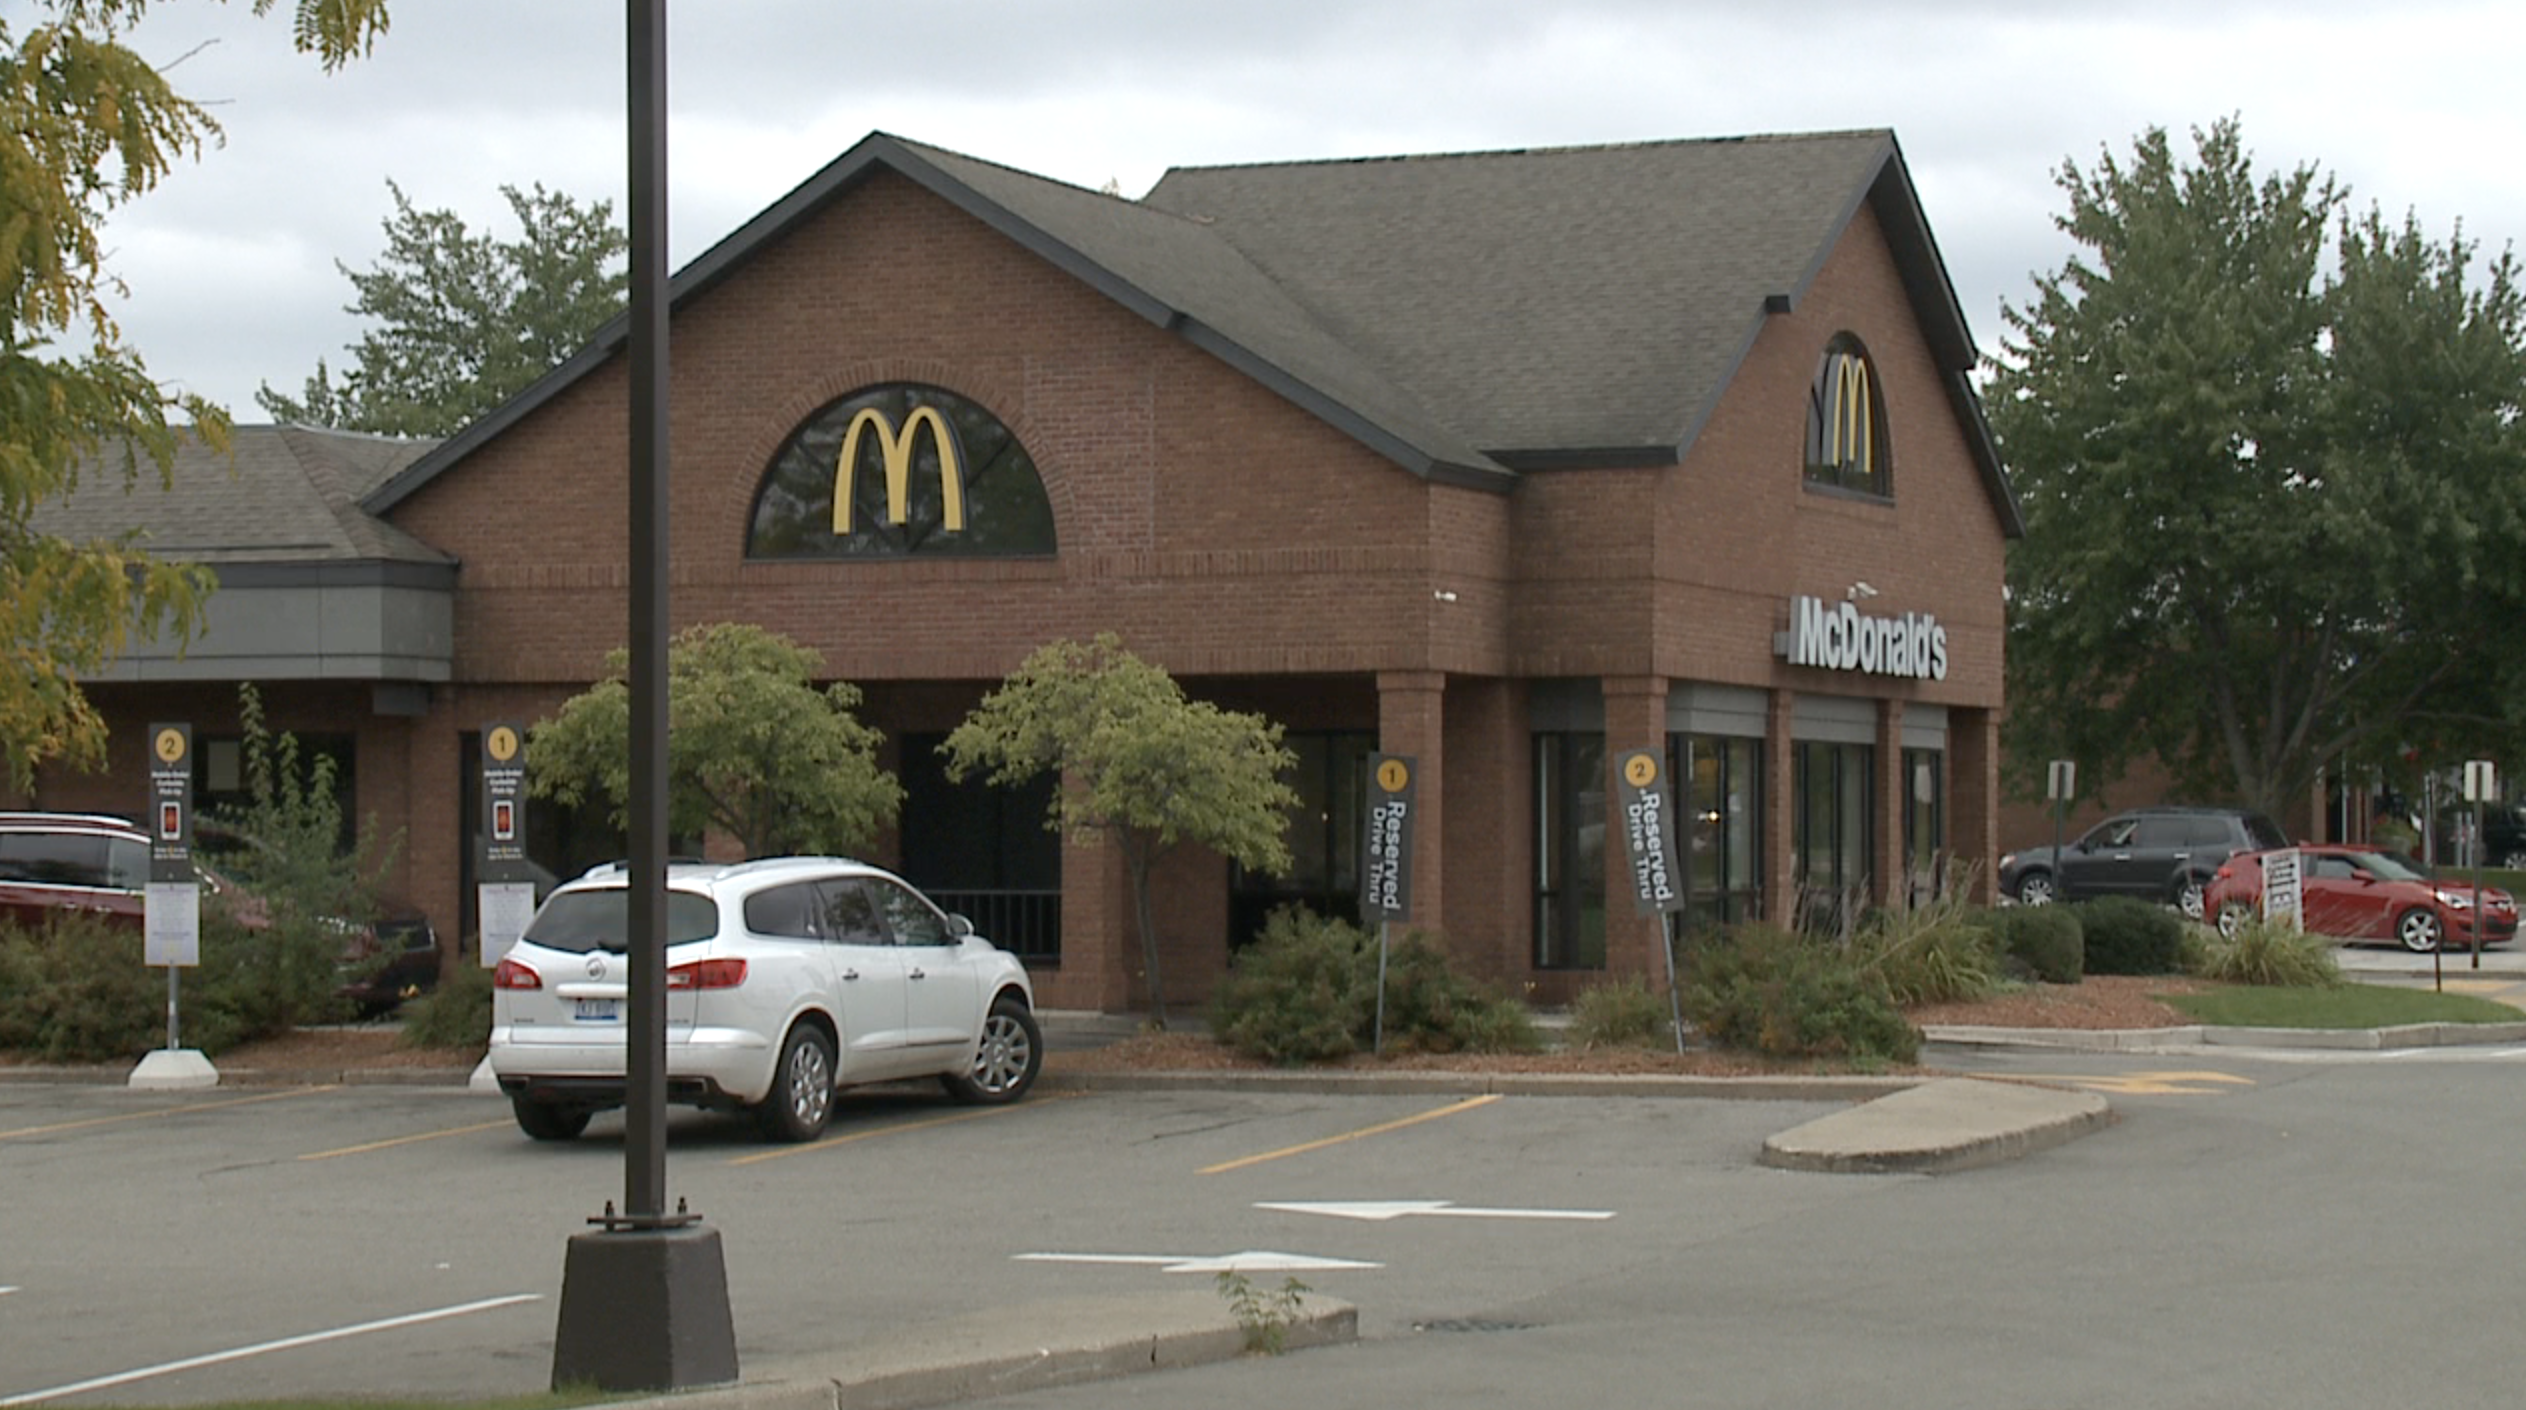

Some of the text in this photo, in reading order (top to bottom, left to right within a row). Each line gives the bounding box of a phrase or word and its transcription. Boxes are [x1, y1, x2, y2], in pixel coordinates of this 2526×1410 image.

[1797, 595, 1948, 681] McDonald's
[164, 737, 176, 754] 2
[1634, 762, 1647, 778] 2
[1369, 807, 1387, 905] Drive Thru
[1383, 801, 1407, 910] Reserved
[1628, 803, 1653, 900] Drive Thru
[1642, 792, 1674, 901] Reserved
